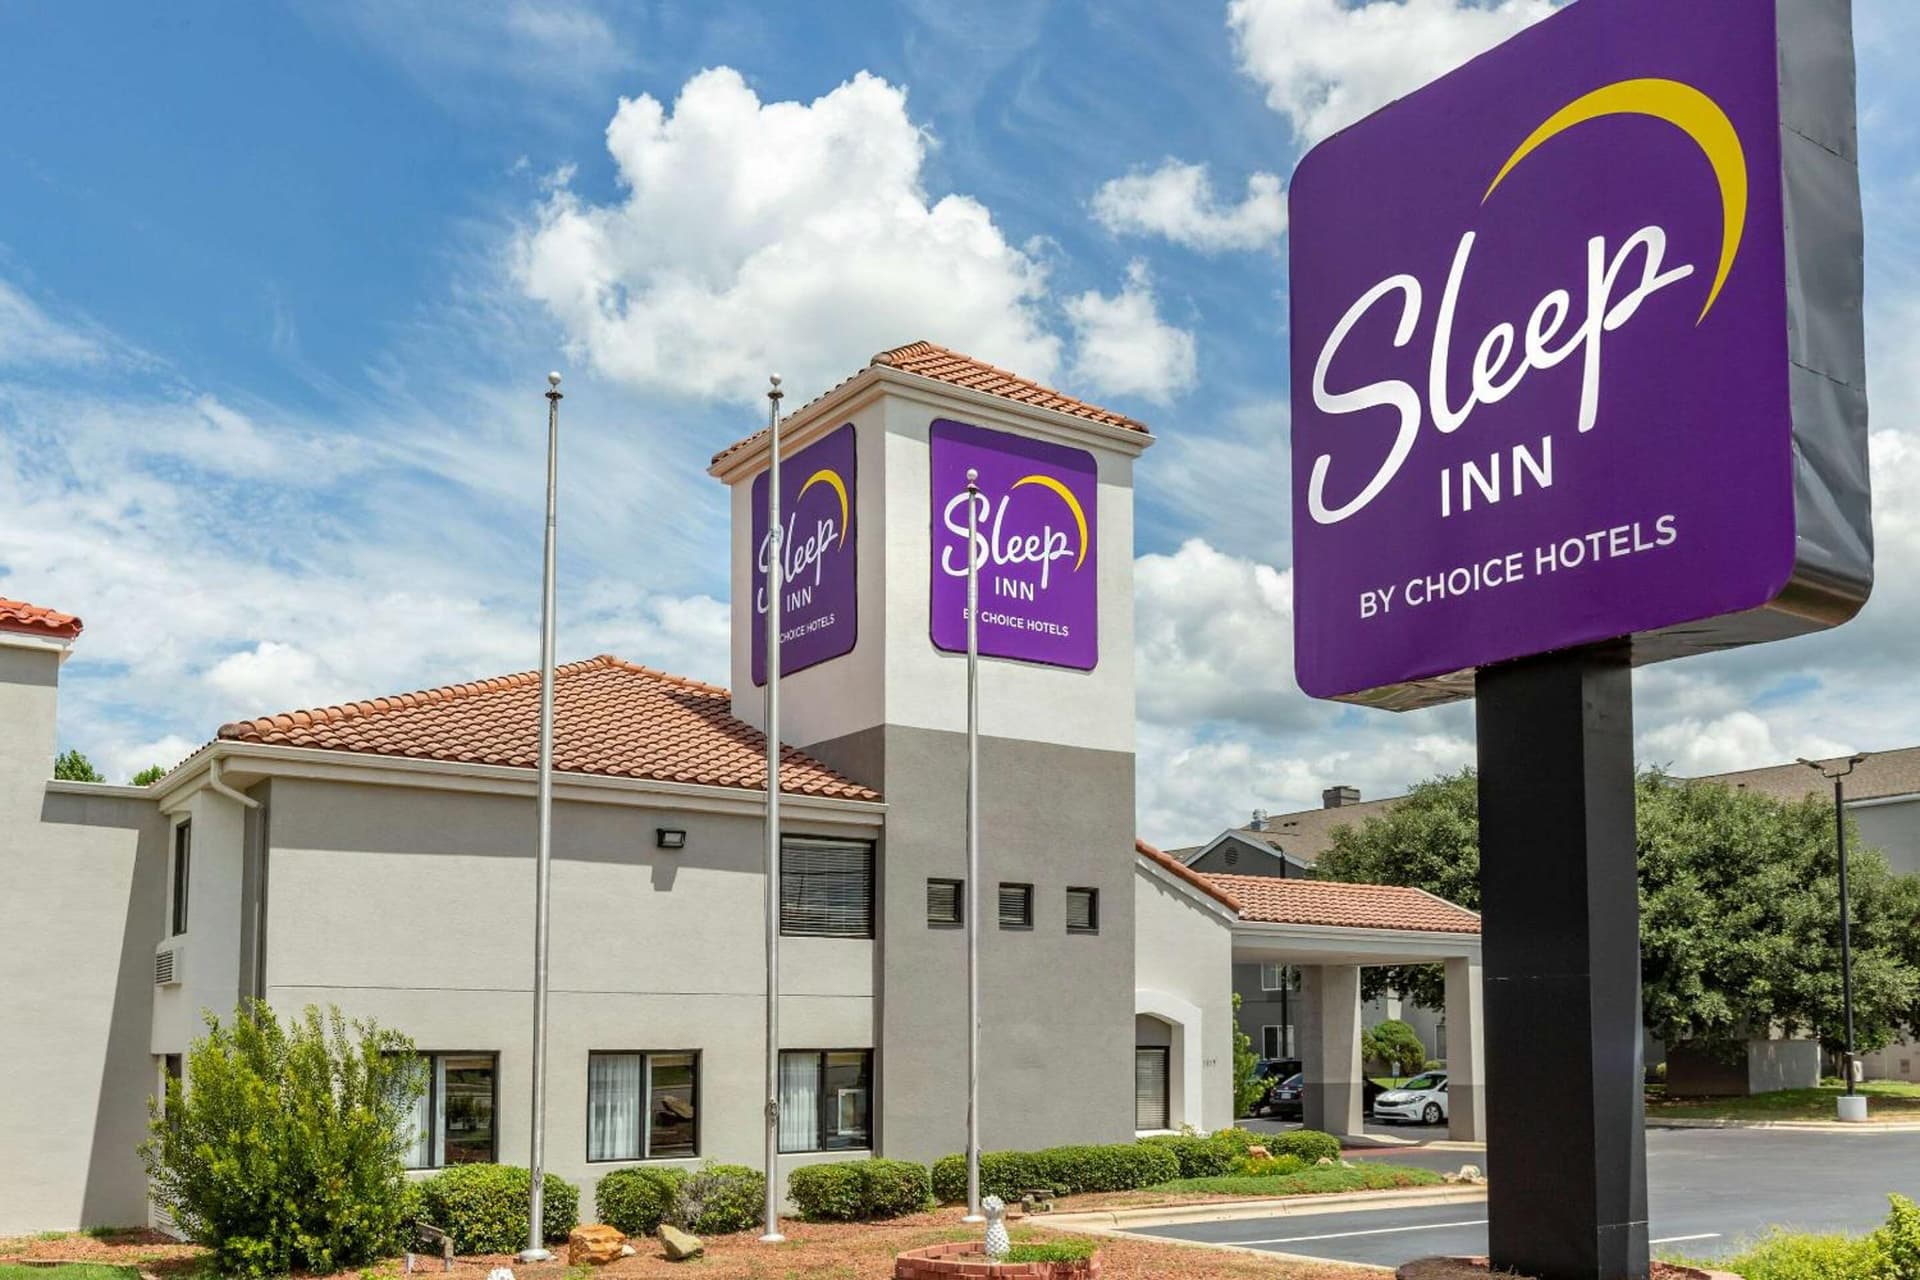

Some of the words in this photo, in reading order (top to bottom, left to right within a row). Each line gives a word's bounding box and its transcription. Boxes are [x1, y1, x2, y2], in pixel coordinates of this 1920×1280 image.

[1307, 225, 1695, 525] Sleep
[1440, 435, 1553, 518] INN
[757, 512, 838, 614] Sleep
[941, 491, 1075, 590] Sleep
[1359, 586, 1396, 619] BY
[1404, 552, 1524, 607] CHOICE
[1535, 514, 1678, 576] HOTELS
[786, 585, 812, 613] INN
[806, 613, 836, 634] HOTELS
[981, 611, 1025, 629] CHOICE
[1027, 619, 1069, 637] HOTELS
[995, 576, 1035, 601] INN
